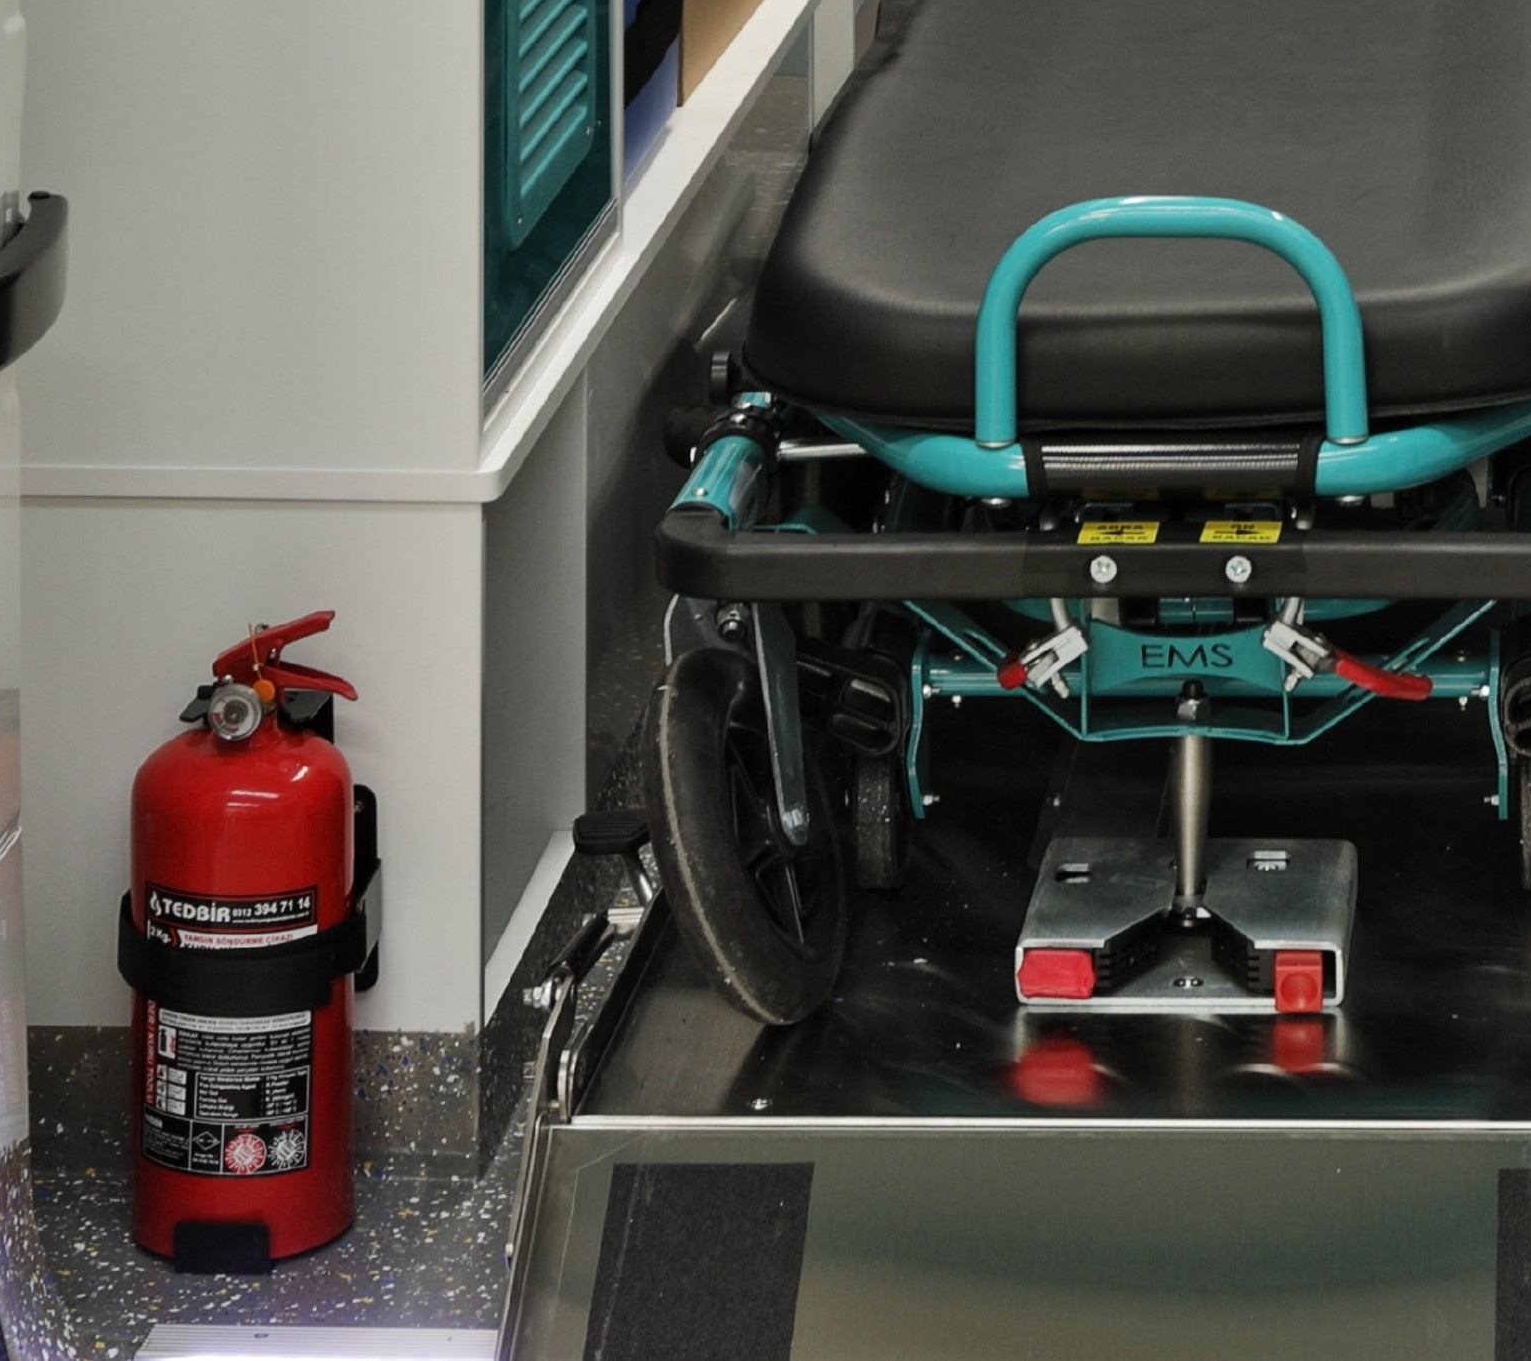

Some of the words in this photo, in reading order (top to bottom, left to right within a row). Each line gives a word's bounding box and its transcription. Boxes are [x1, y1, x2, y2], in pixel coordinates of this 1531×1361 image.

[1141, 642, 1234, 671] EMS
[162, 898, 232, 923] TEDBİR
[254, 902, 278, 917] 394
[280, 899, 294, 913] 71
[298, 896, 311, 910] 14
[183, 933, 215, 945] YANGIN
[215, 935, 265, 946] SÖNDÜRME
